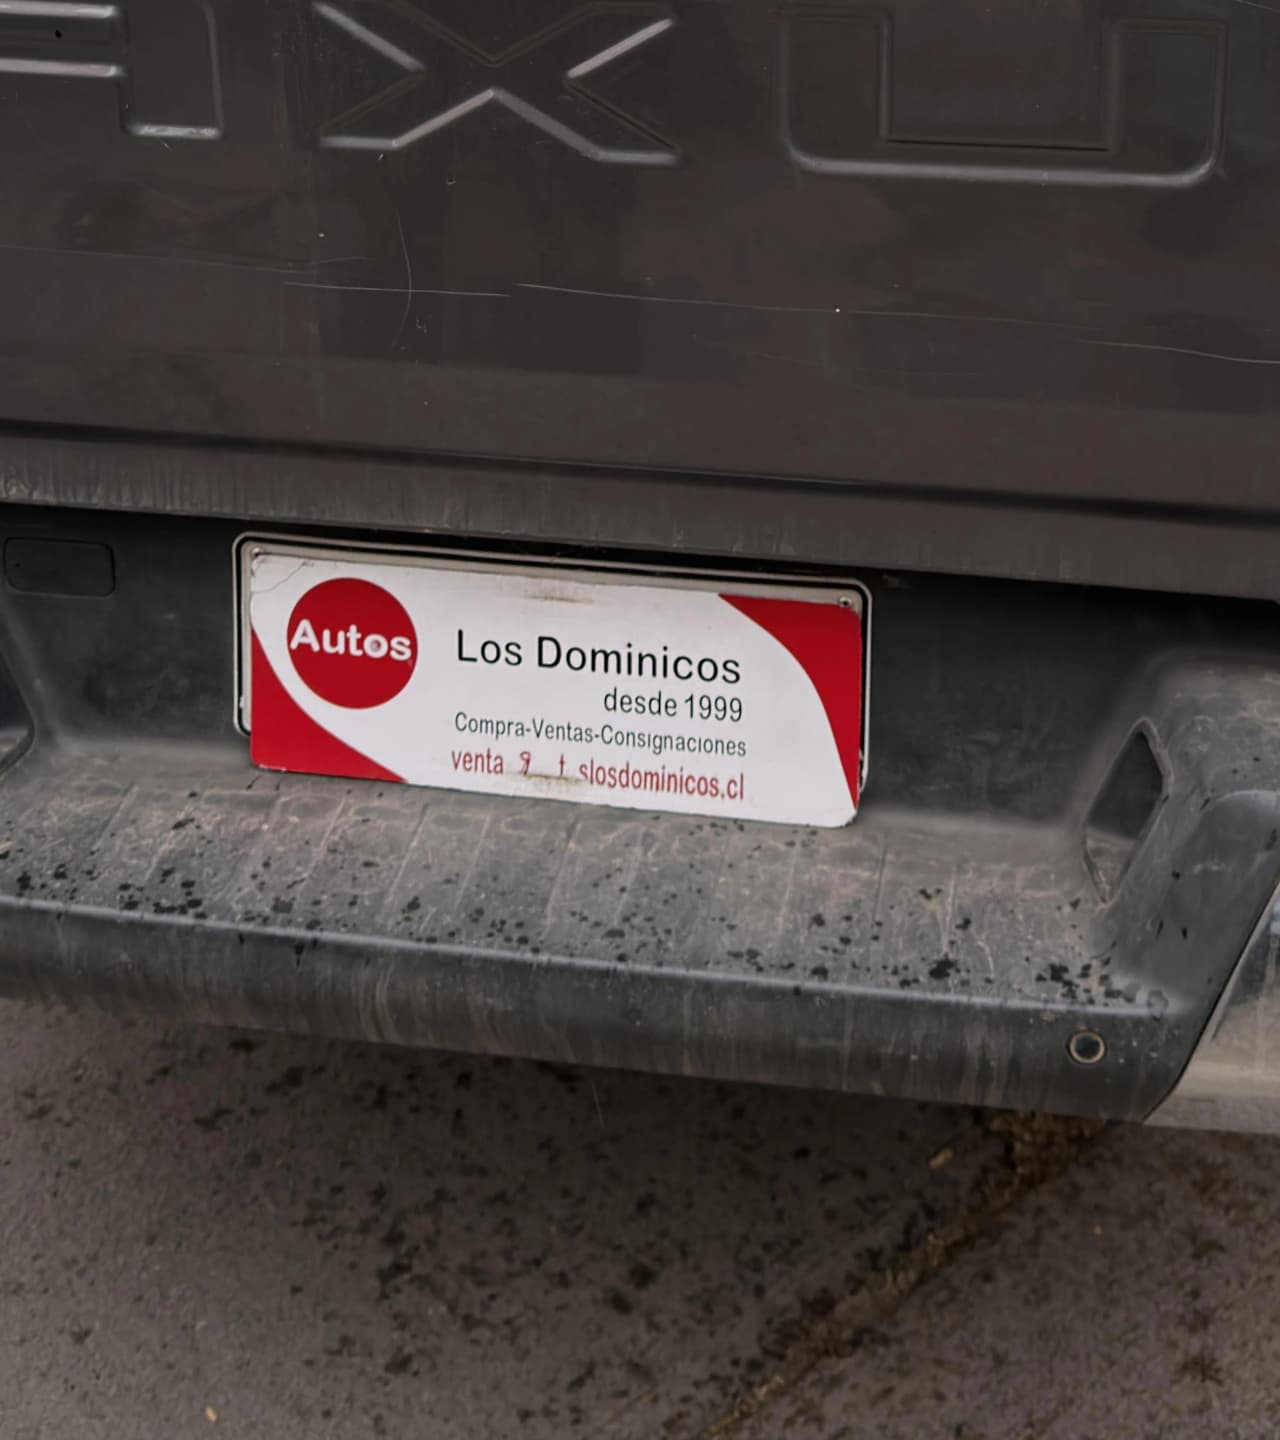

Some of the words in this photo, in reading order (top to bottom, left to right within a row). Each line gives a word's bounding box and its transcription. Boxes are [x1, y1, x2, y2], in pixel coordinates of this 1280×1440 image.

[289, 618, 412, 662] Autos
[456, 629, 523, 667] Los
[536, 635, 741, 684] Dominicos
[603, 686, 678, 717] desde
[683, 693, 743, 723] 1999
